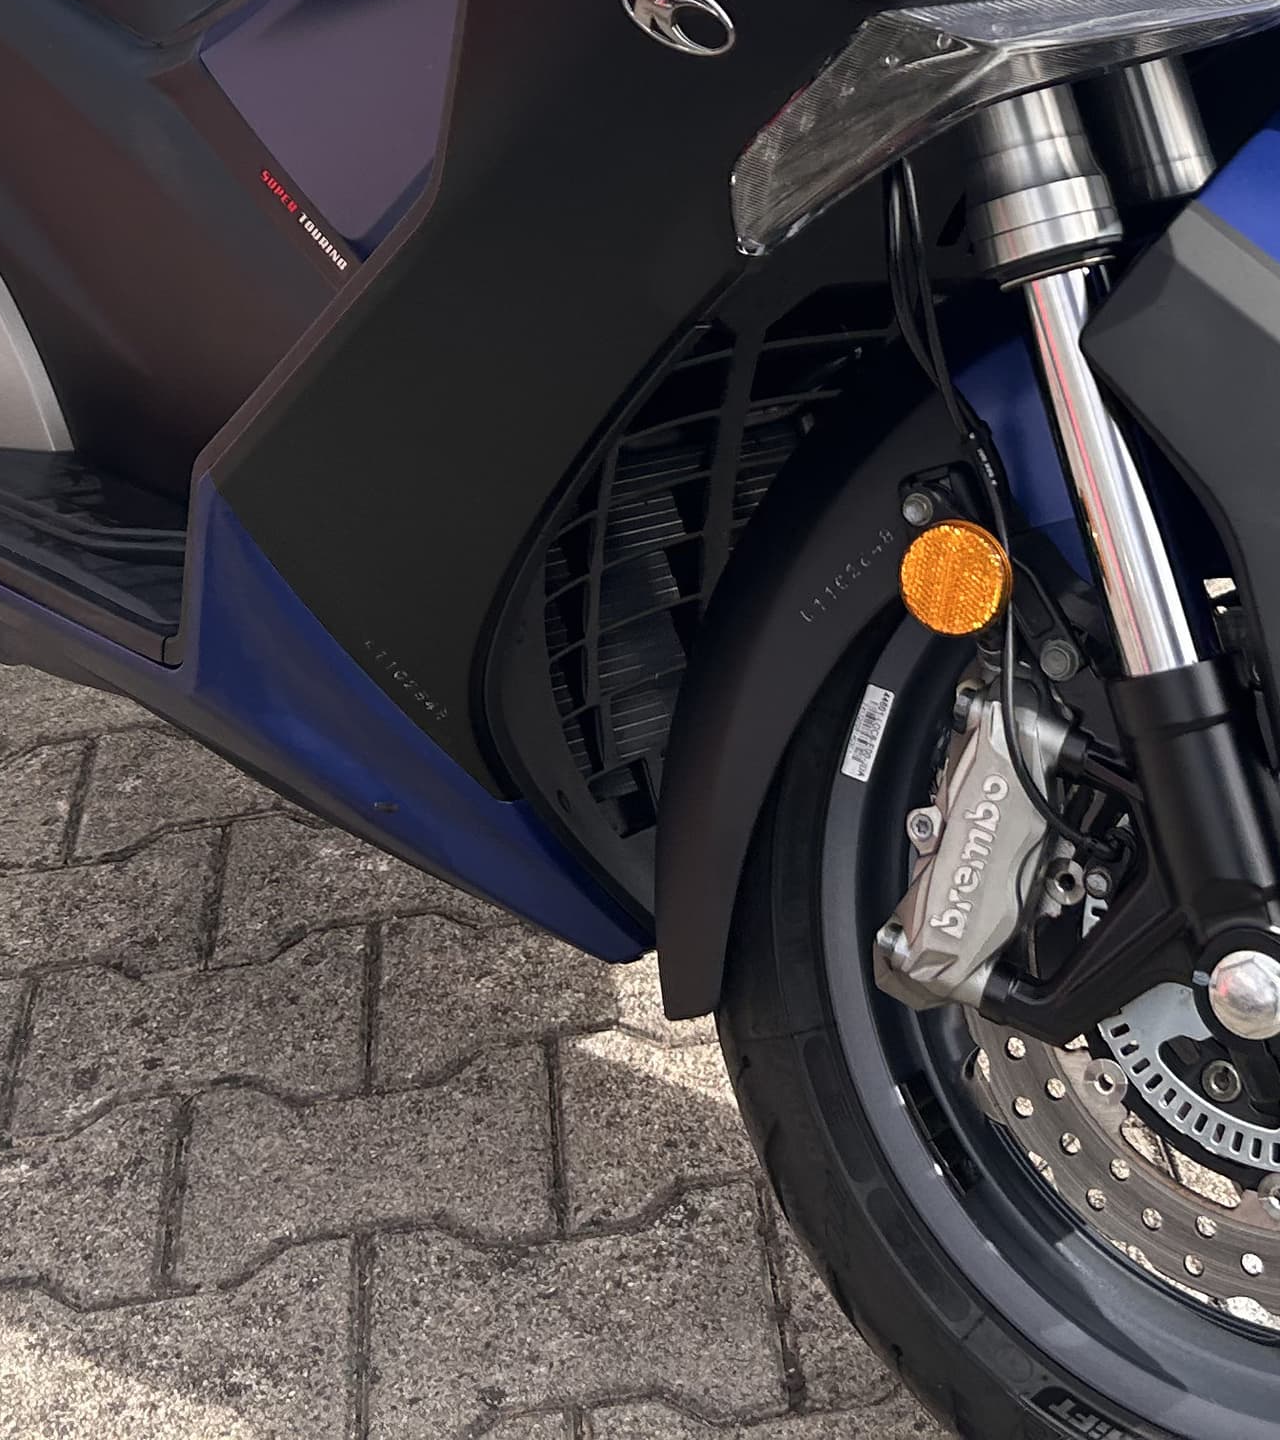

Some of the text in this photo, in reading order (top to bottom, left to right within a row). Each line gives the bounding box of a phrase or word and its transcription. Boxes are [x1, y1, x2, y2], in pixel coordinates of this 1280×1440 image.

[260, 169, 348, 271] SUPER TOURING
[929, 774, 1009, 939] brembo
